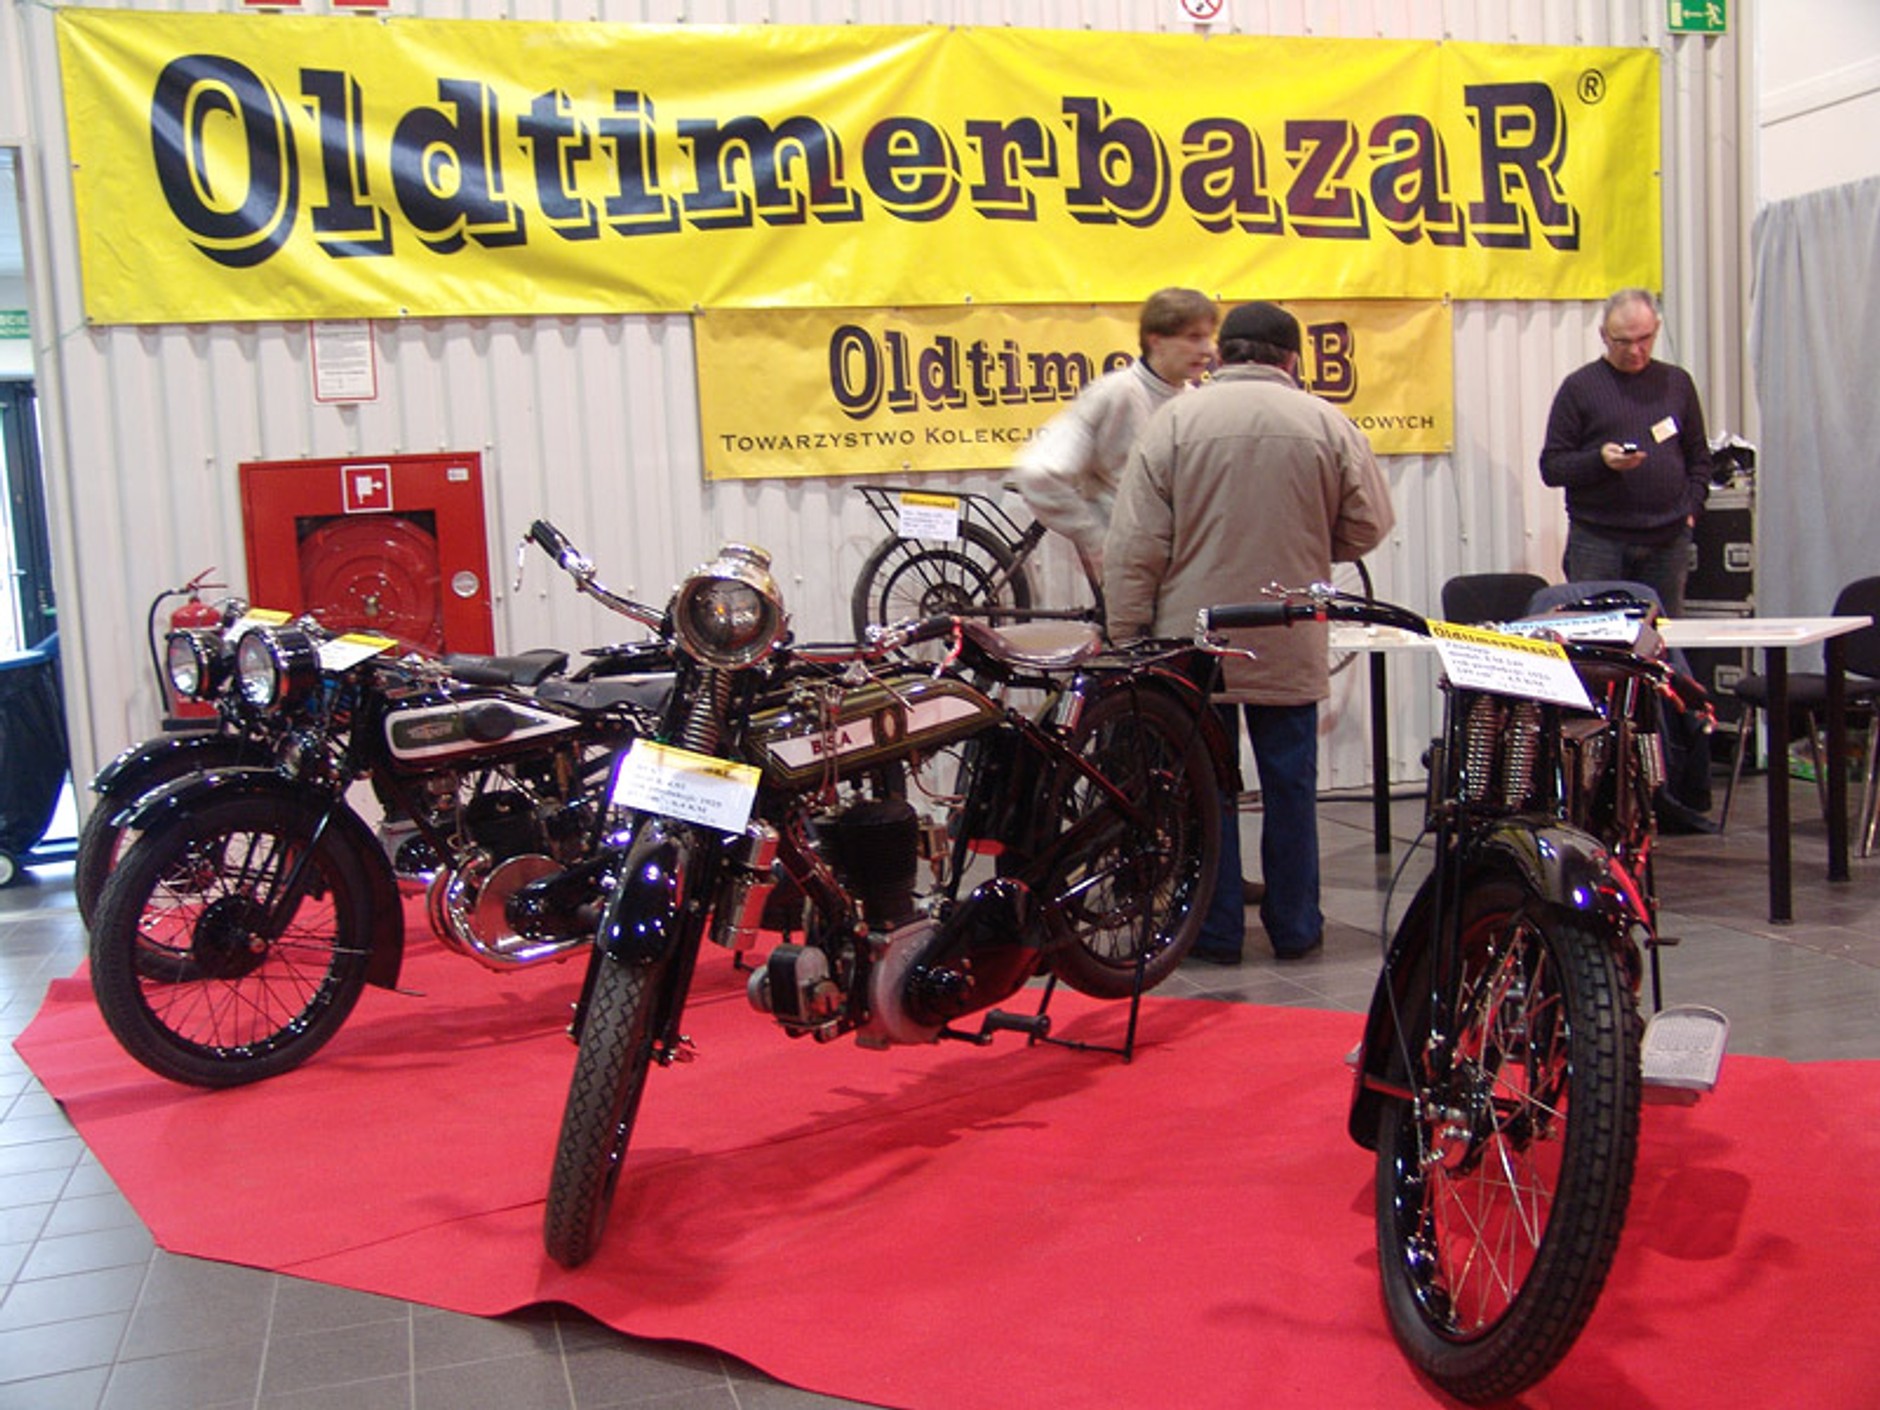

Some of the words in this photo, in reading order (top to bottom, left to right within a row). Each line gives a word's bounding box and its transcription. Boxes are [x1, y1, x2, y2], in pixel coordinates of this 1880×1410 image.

[151, 54, 1579, 269] OldtimerbazaR
[721, 429, 916, 453] TOWARZYSTWO
[1347, 415, 1434, 430] KOWYCH
[810, 733, 853, 756] BSA
